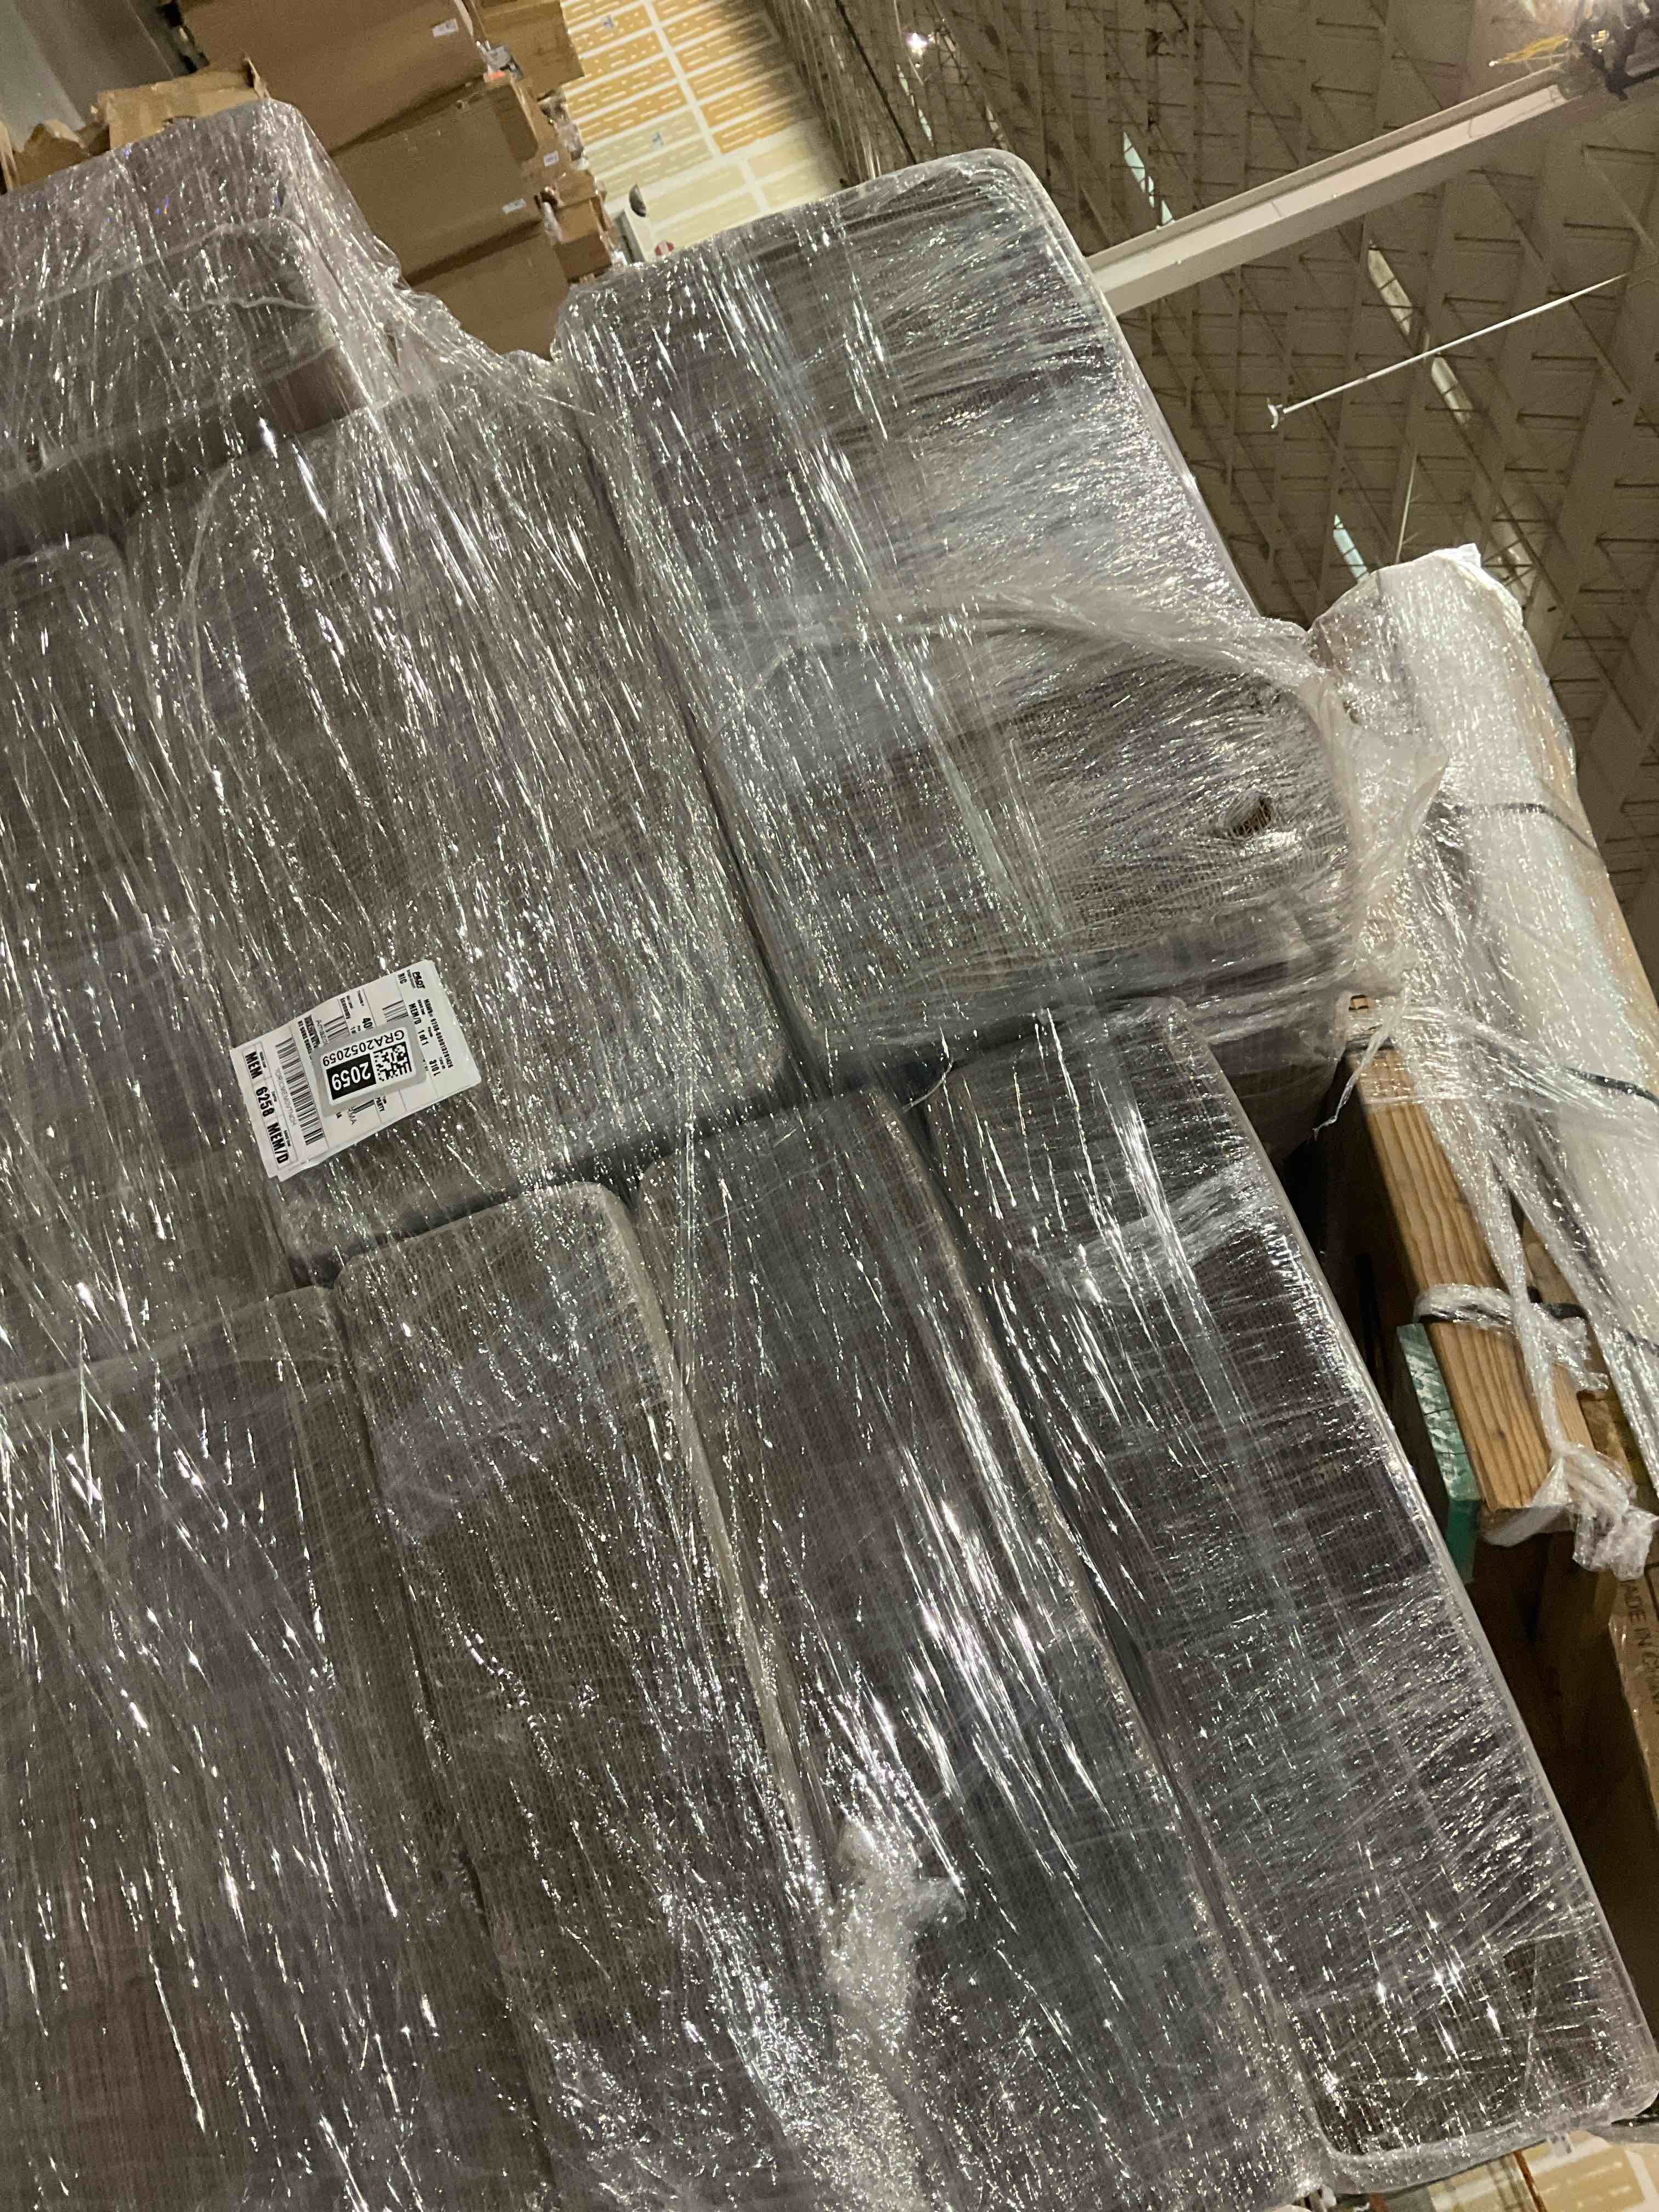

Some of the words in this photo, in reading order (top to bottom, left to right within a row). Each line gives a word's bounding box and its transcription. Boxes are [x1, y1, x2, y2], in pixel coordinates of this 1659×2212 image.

[398, 973, 407, 984] RIC
[412, 971, 425, 989] PILOT
[409, 1003, 421, 1025] MEM/D
[323, 1030, 404, 1066] GRA2052059
[332, 1062, 371, 1091] 2059
[245, 1052, 262, 1079] MEM
[256, 1086, 274, 1117] 6258
[267, 1122, 288, 1164] MEM/D
